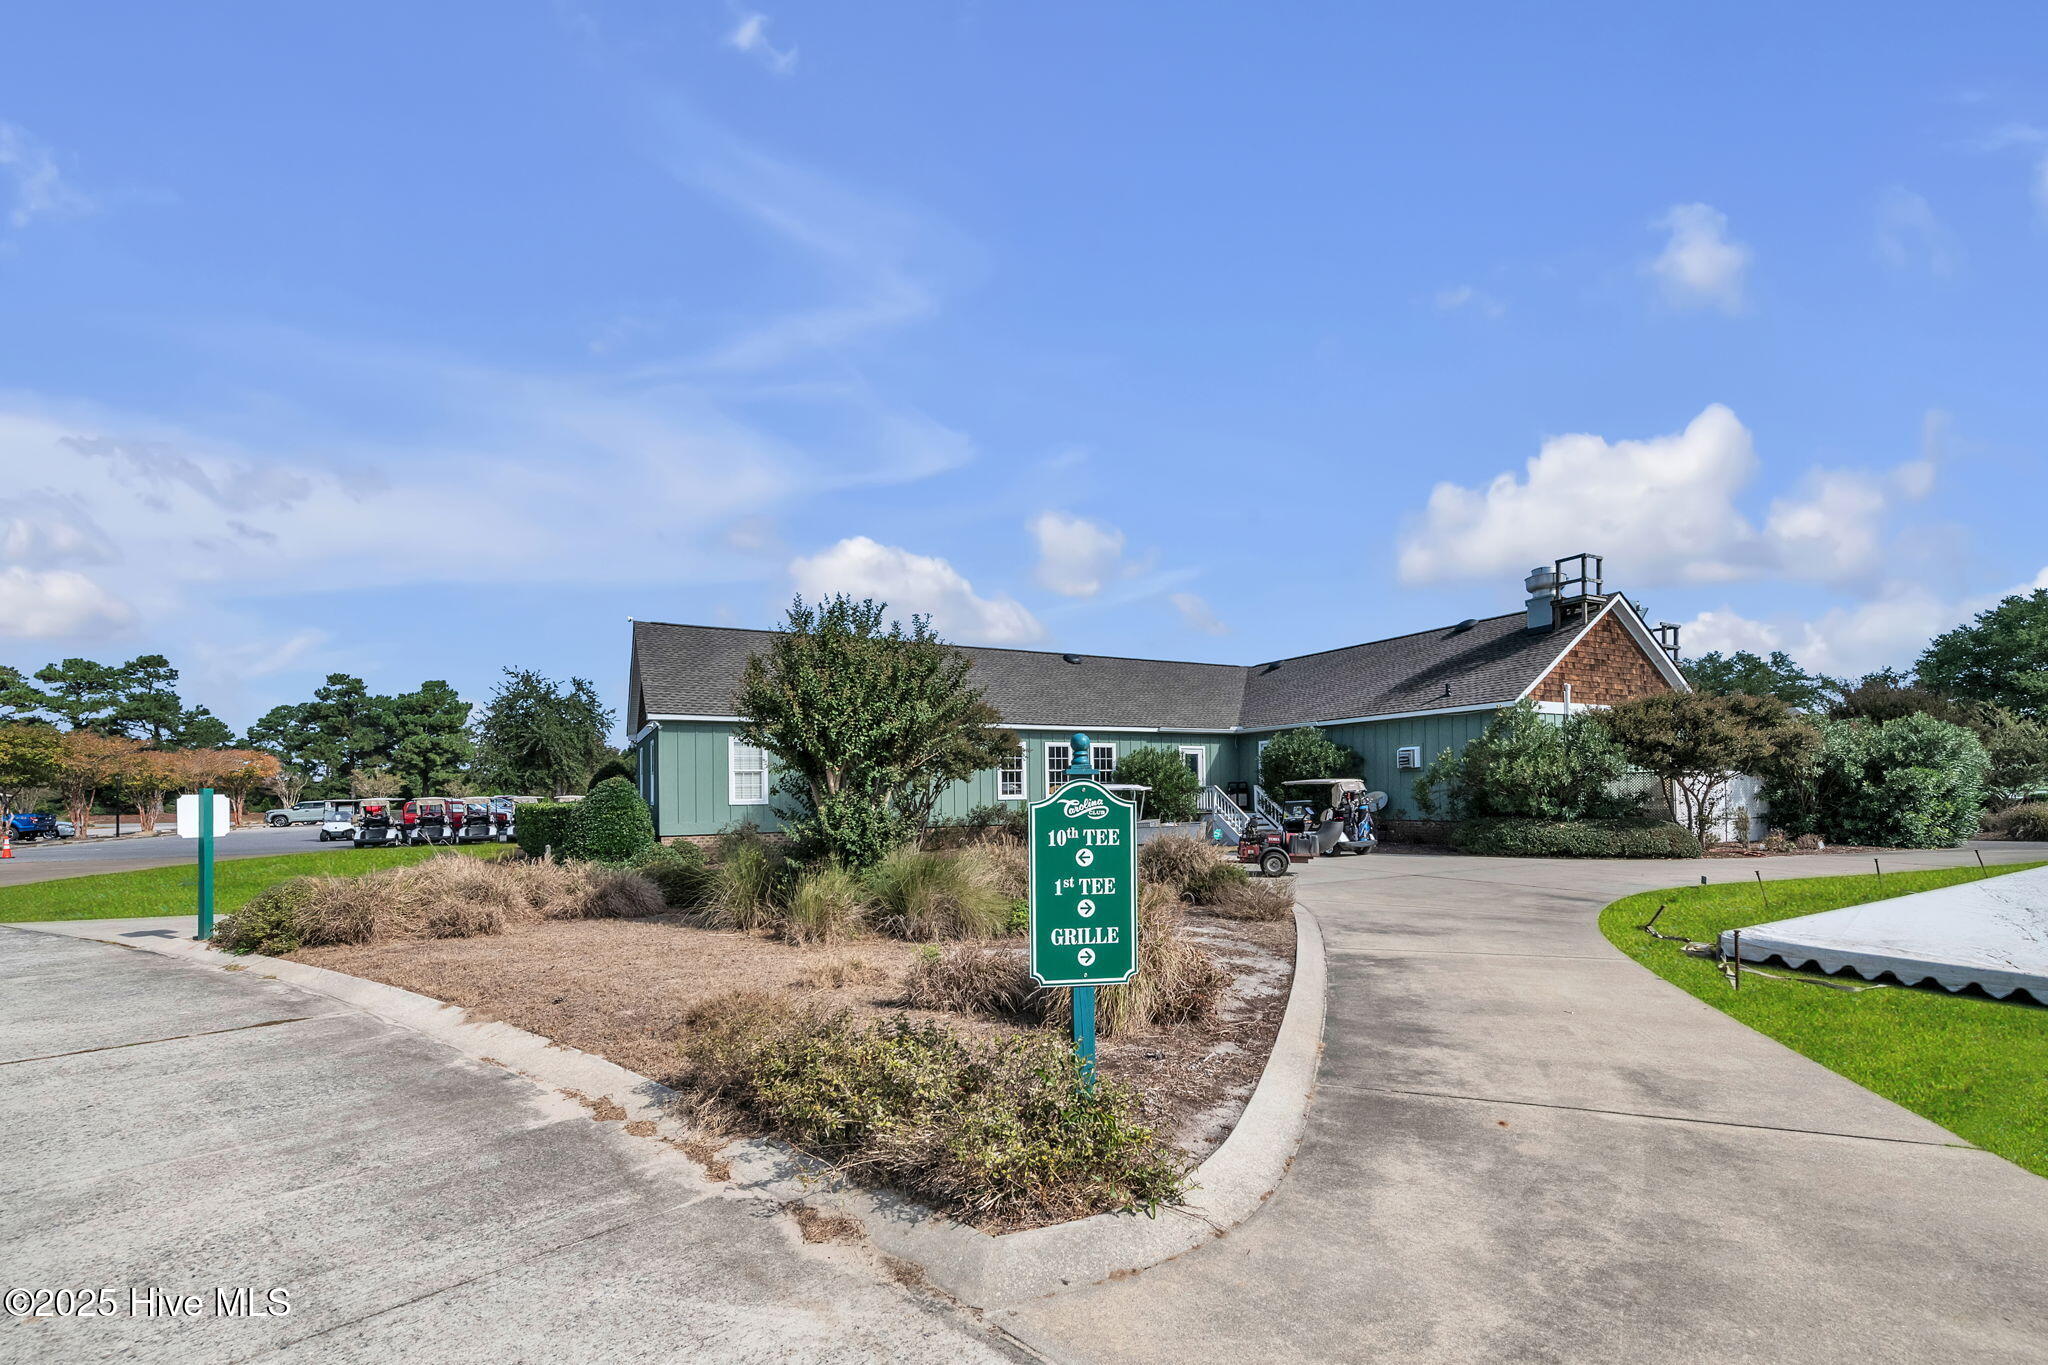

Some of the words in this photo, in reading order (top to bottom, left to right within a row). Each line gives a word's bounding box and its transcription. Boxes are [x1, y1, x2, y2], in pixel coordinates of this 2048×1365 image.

[1057, 799, 1104, 818] Carolina
[1048, 826, 1079, 847] 10th
[1083, 828, 1120, 846] TEE
[1055, 876, 1075, 896] 1st
[1079, 877, 1116, 895] TEE
[1051, 926, 1120, 946] GRILLE
